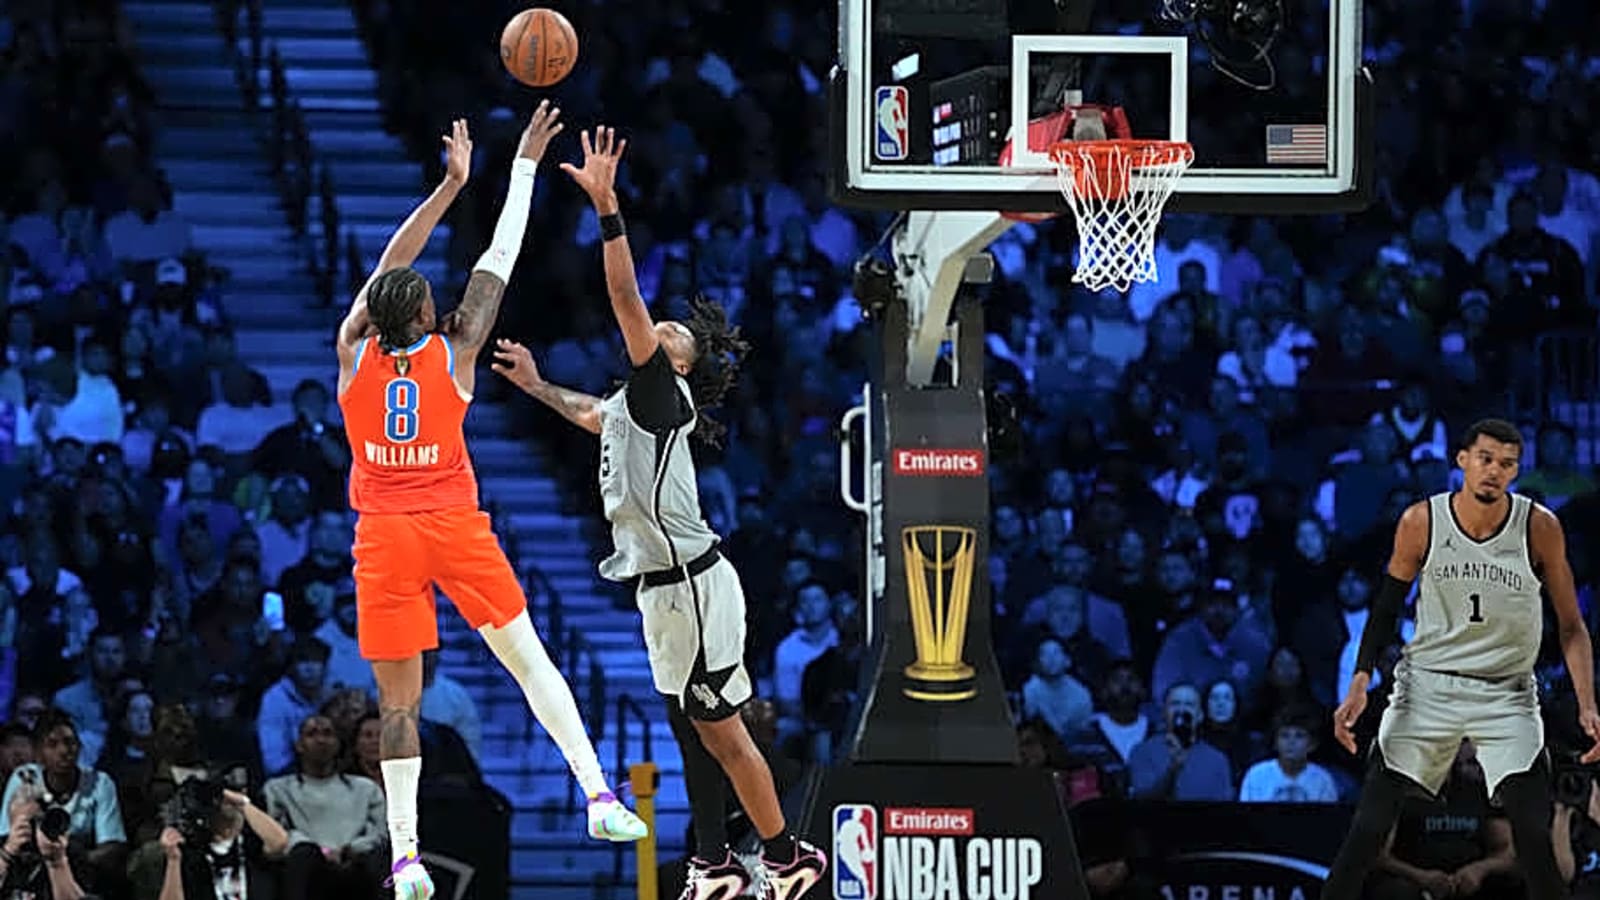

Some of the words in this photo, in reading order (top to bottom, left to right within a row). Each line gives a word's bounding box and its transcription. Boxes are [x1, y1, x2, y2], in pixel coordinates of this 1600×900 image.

[384, 377, 420, 443] 8
[364, 440, 439, 466] WILLIAMS
[898, 451, 978, 470] Emirates
[1434, 563, 1459, 581] SAN
[1462, 562, 1522, 591] ANTONIO
[1469, 593, 1484, 622] 1
[890, 811, 969, 830] Emirates
[883, 837, 960, 900] NBA
[966, 837, 1042, 900] CUP
